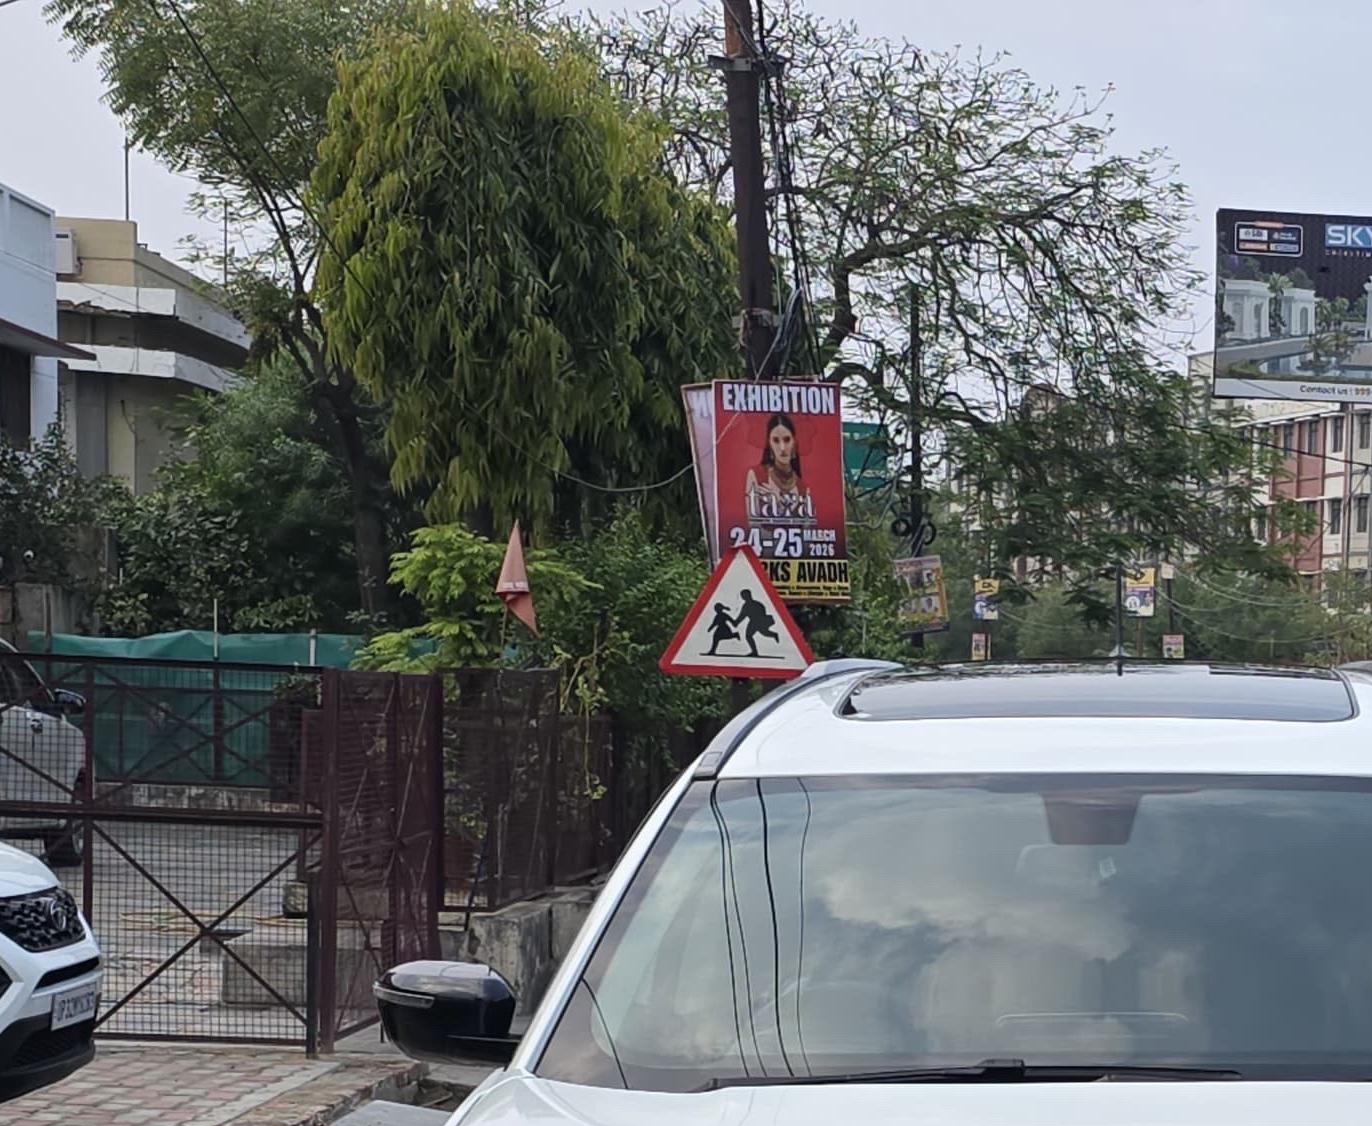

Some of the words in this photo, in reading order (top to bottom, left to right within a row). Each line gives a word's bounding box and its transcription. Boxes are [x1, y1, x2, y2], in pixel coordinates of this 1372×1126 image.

[1300, 385, 1336, 394] Contact
[722, 383, 836, 414] EXHIBITION
[803, 529, 837, 542] MARCH
[809, 543, 835, 556] 2026
[797, 561, 849, 583] AVADH
